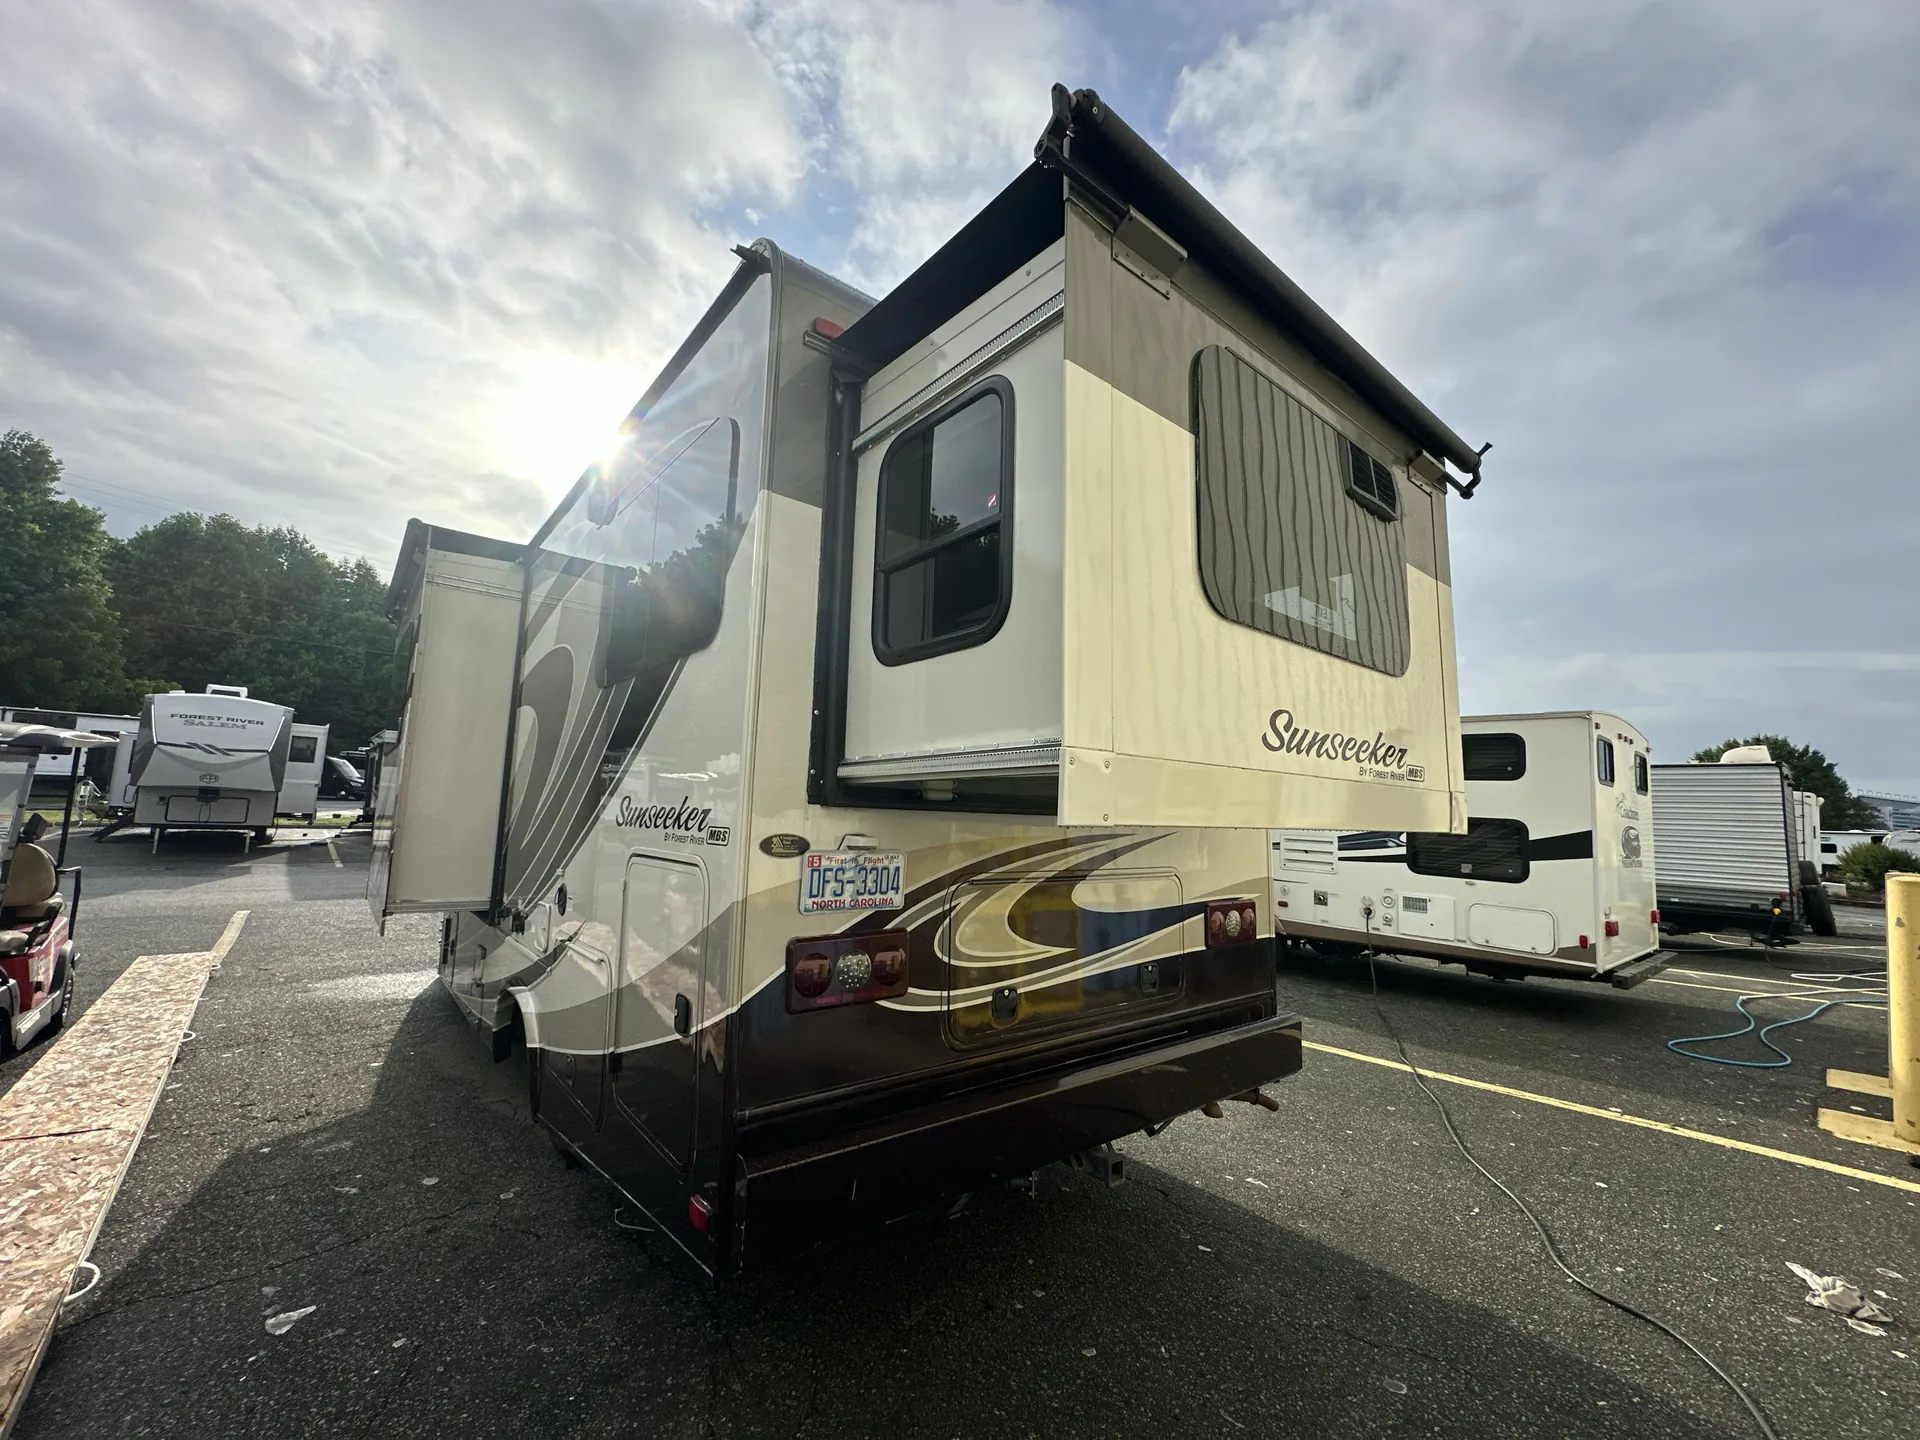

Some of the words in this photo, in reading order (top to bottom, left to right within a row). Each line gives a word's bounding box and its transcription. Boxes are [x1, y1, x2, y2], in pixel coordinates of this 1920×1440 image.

[170, 713, 223, 721] FOREST
[226, 717, 265, 725] RIVER
[183, 719, 248, 730] SALEM
[1261, 709, 1408, 770] Sunseeker
[1408, 767, 1423, 779] MBS
[616, 795, 712, 832] Sunseeker
[708, 829, 728, 842] MBS
[813, 856, 820, 866] 5
[809, 866, 901, 898] DFS-3304
[812, 899, 846, 909] NORTH
[849, 897, 894, 907] CAROLINA
